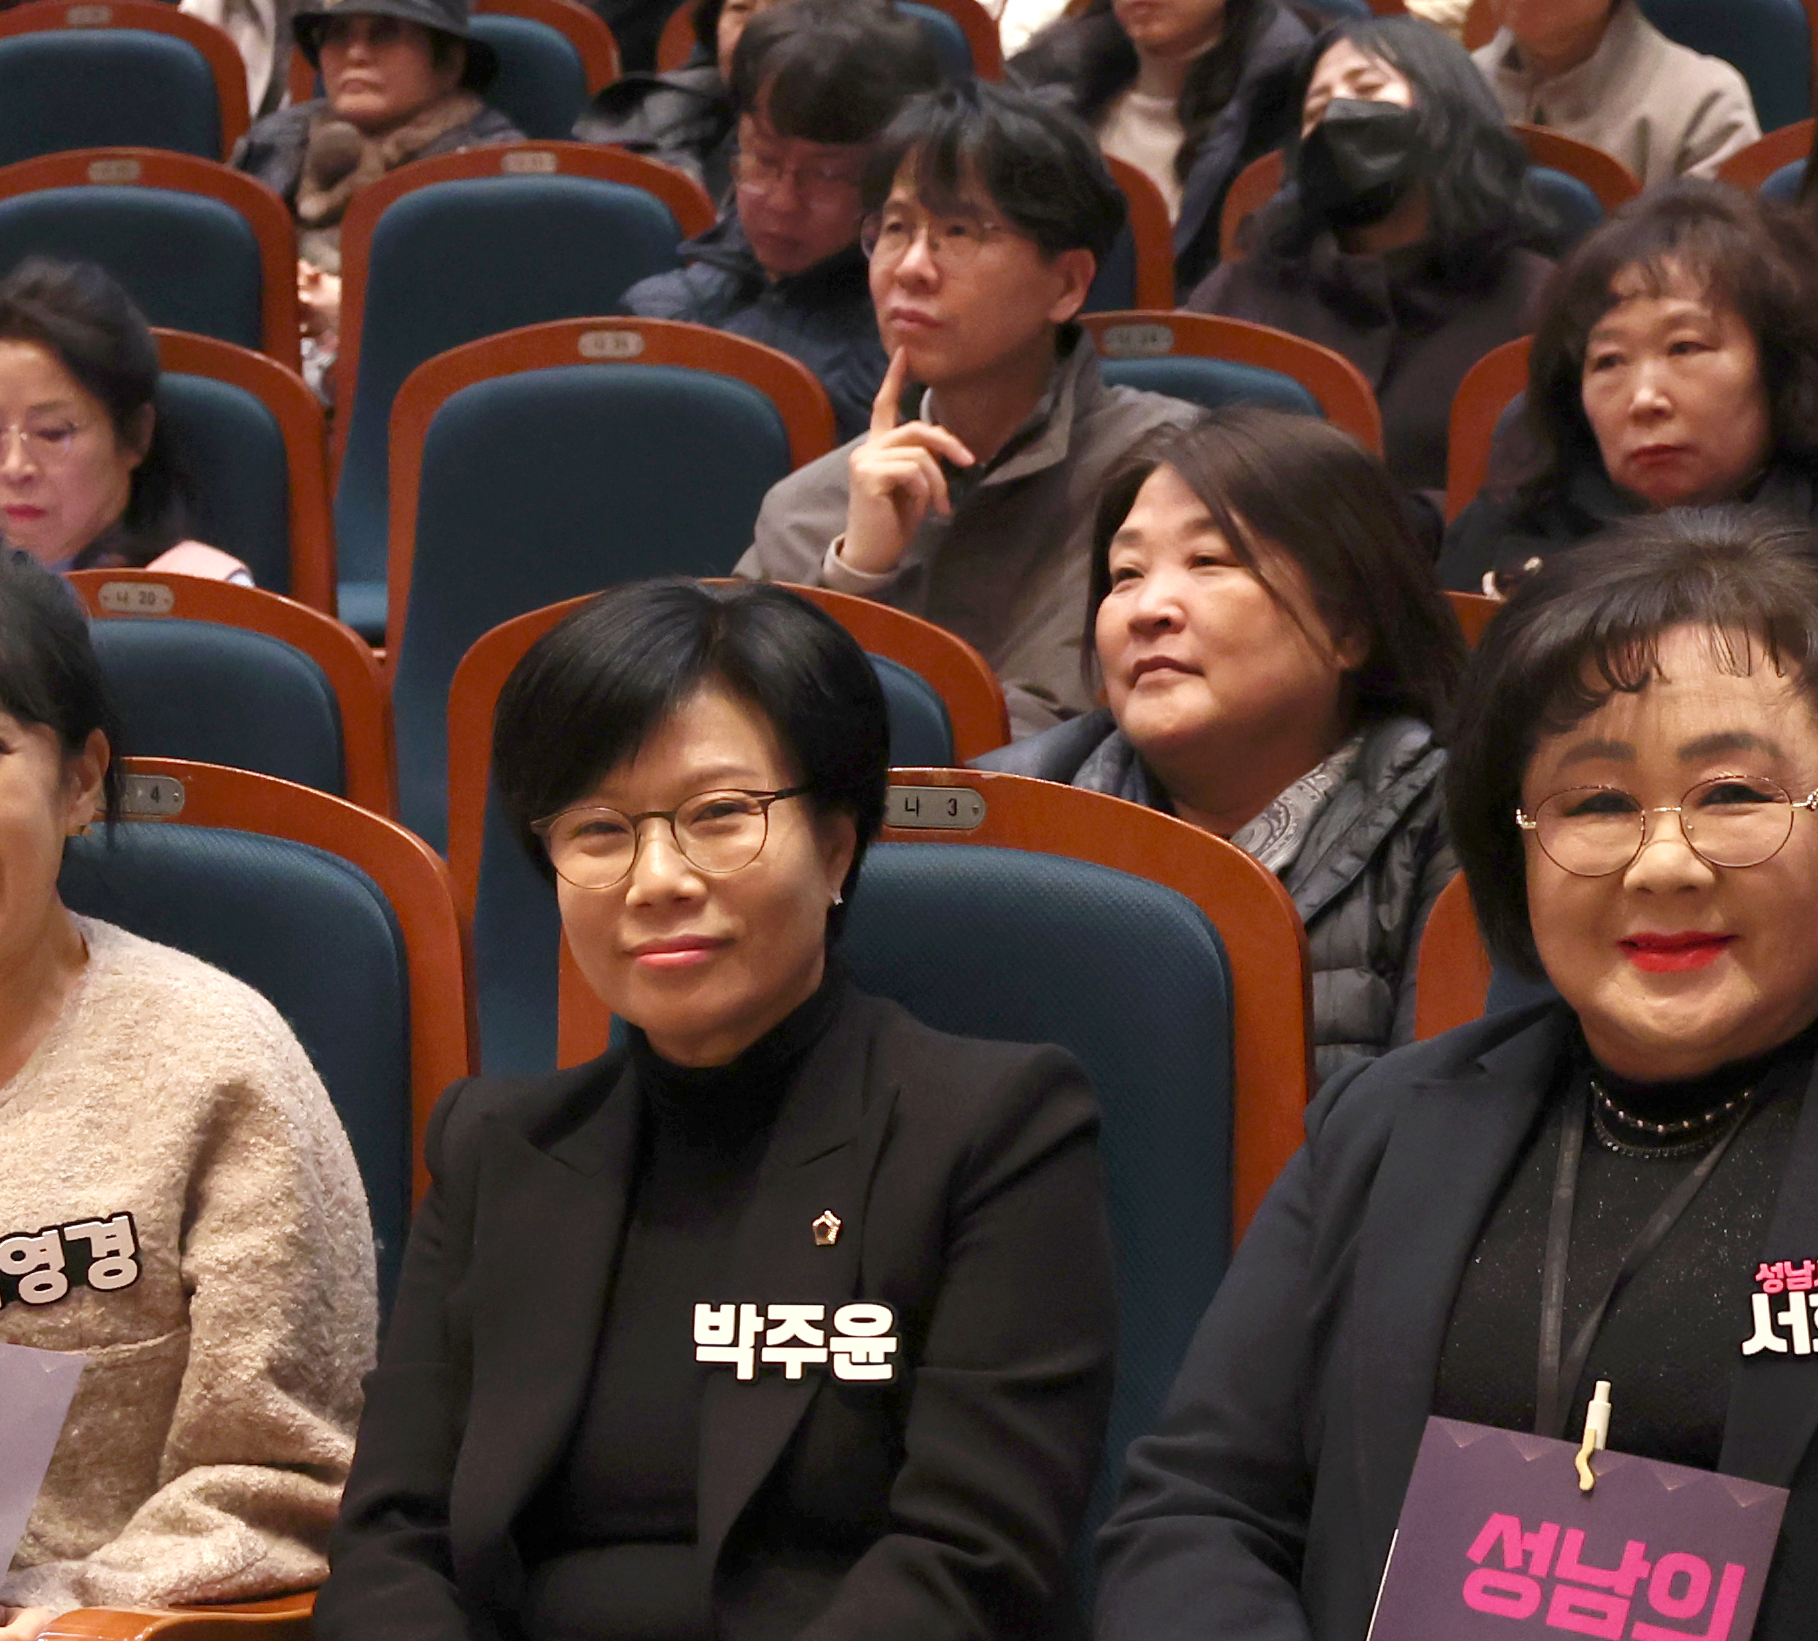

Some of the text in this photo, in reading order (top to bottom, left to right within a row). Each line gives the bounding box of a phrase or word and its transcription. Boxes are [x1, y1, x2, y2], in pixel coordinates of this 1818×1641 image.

[150, 785, 161, 803] 4
[947, 797, 958, 817] 3
[692, 1302, 898, 1381] 박주윤
